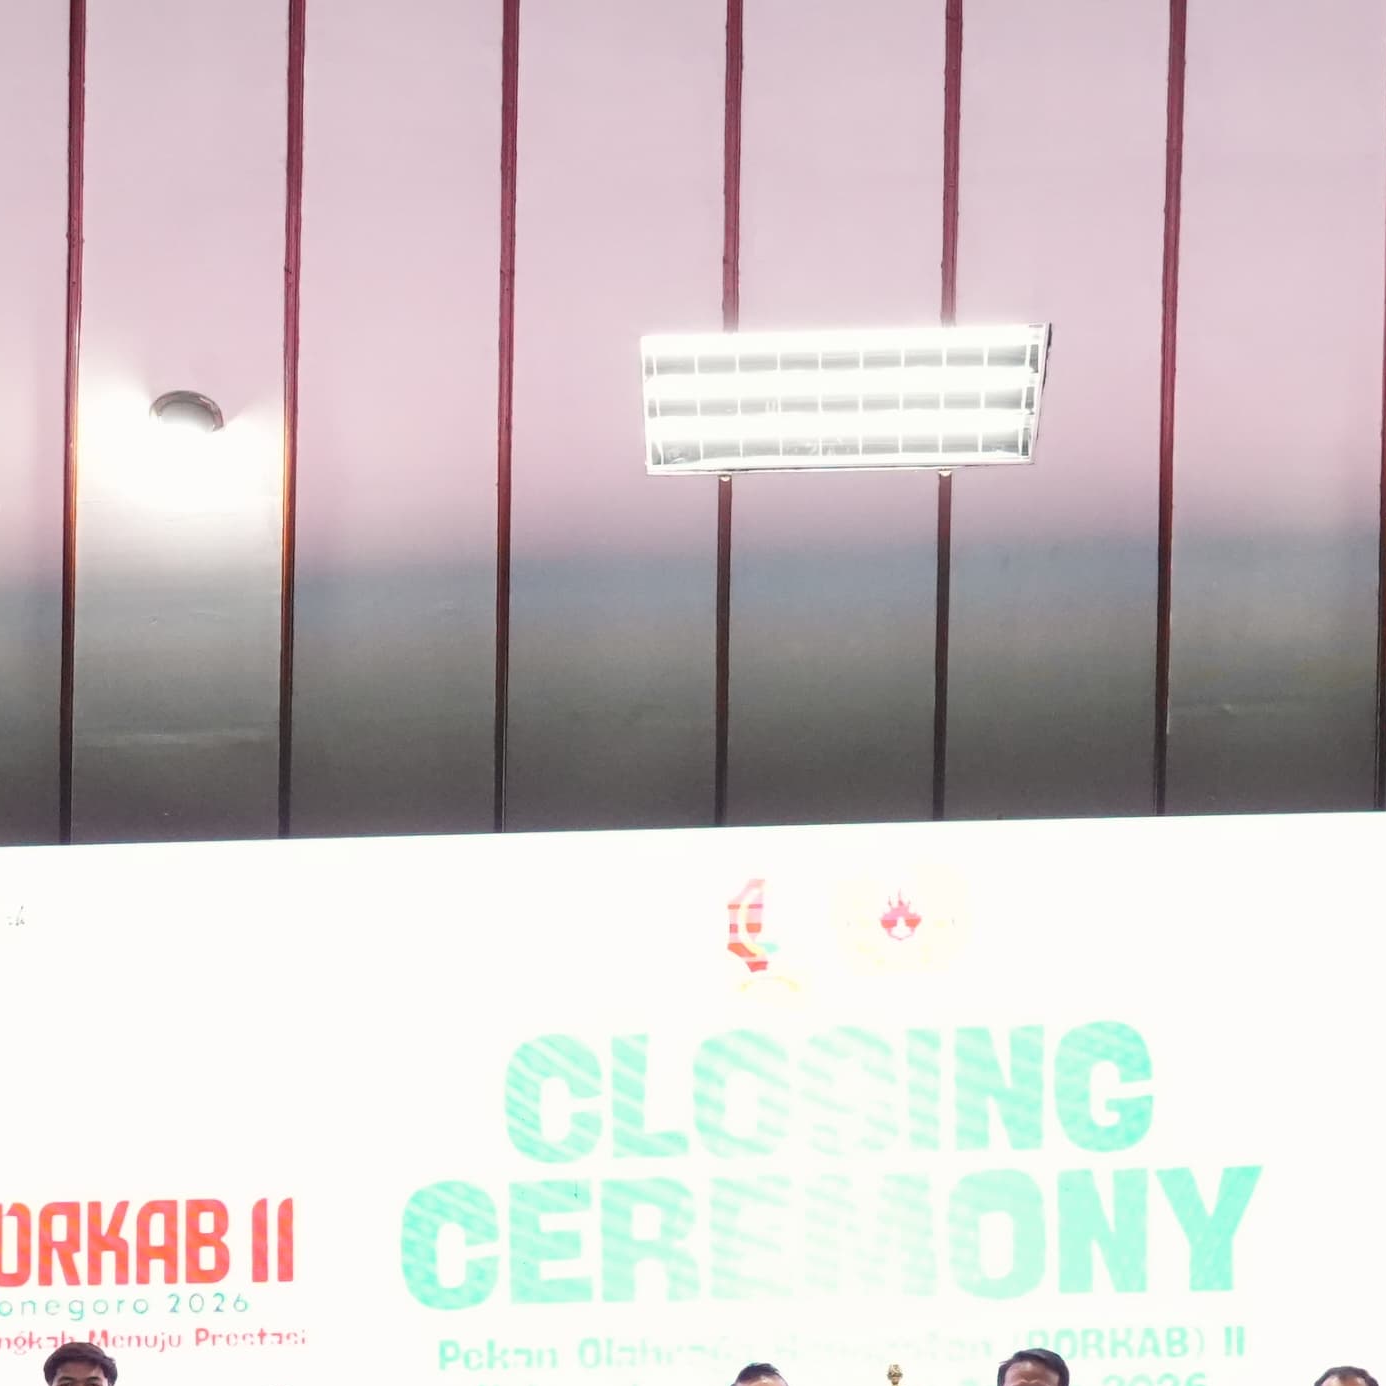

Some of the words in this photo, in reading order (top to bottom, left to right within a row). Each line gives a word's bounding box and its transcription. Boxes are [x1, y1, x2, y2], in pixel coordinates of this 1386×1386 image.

[505, 1020, 1155, 1164] CLOSING
[252, 1198, 293, 1283] II
[400, 1165, 1263, 1311] CEREMONY
[168, 1293, 249, 1313] 2026
